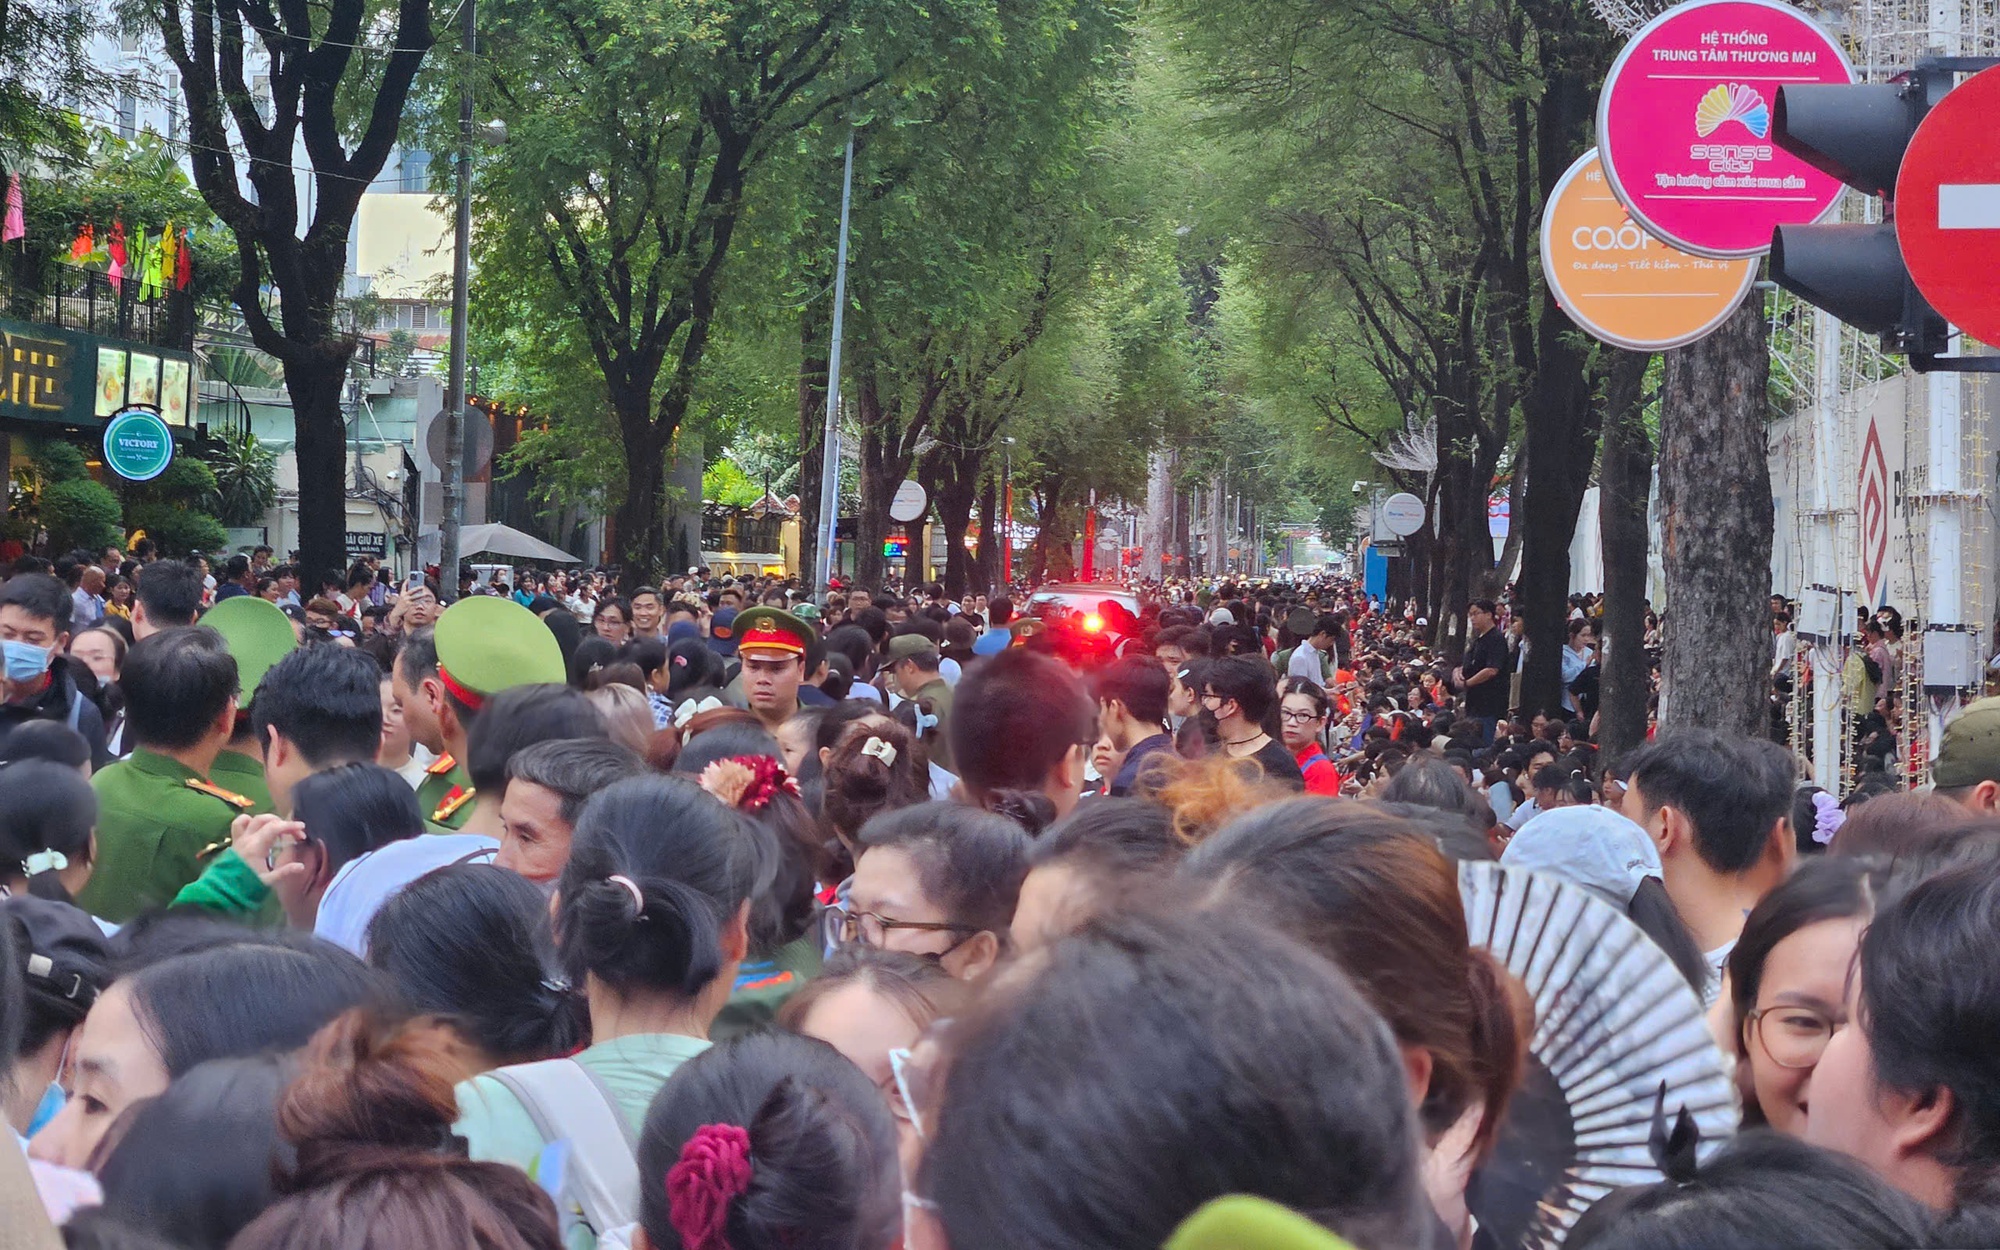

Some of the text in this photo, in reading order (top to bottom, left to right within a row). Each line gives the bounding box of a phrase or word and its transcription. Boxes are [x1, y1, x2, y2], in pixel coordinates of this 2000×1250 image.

[1701, 30, 1768, 46] HỆ THỐNG
[1652, 48, 1816, 65] TRUNG TÂM THƯƠNG MẠI
[1690, 144, 1772, 161] sense
[1709, 157, 1753, 172] city
[1585, 170, 1602, 183] HỆ
[1655, 173, 1676, 188] Tận
[1736, 175, 1757, 188] xúc
[1757, 177, 1781, 188] mua
[1591, 260, 1618, 272] dạng
[118, 438, 159, 449] VICTORY
[373, 535, 384, 546] XE
